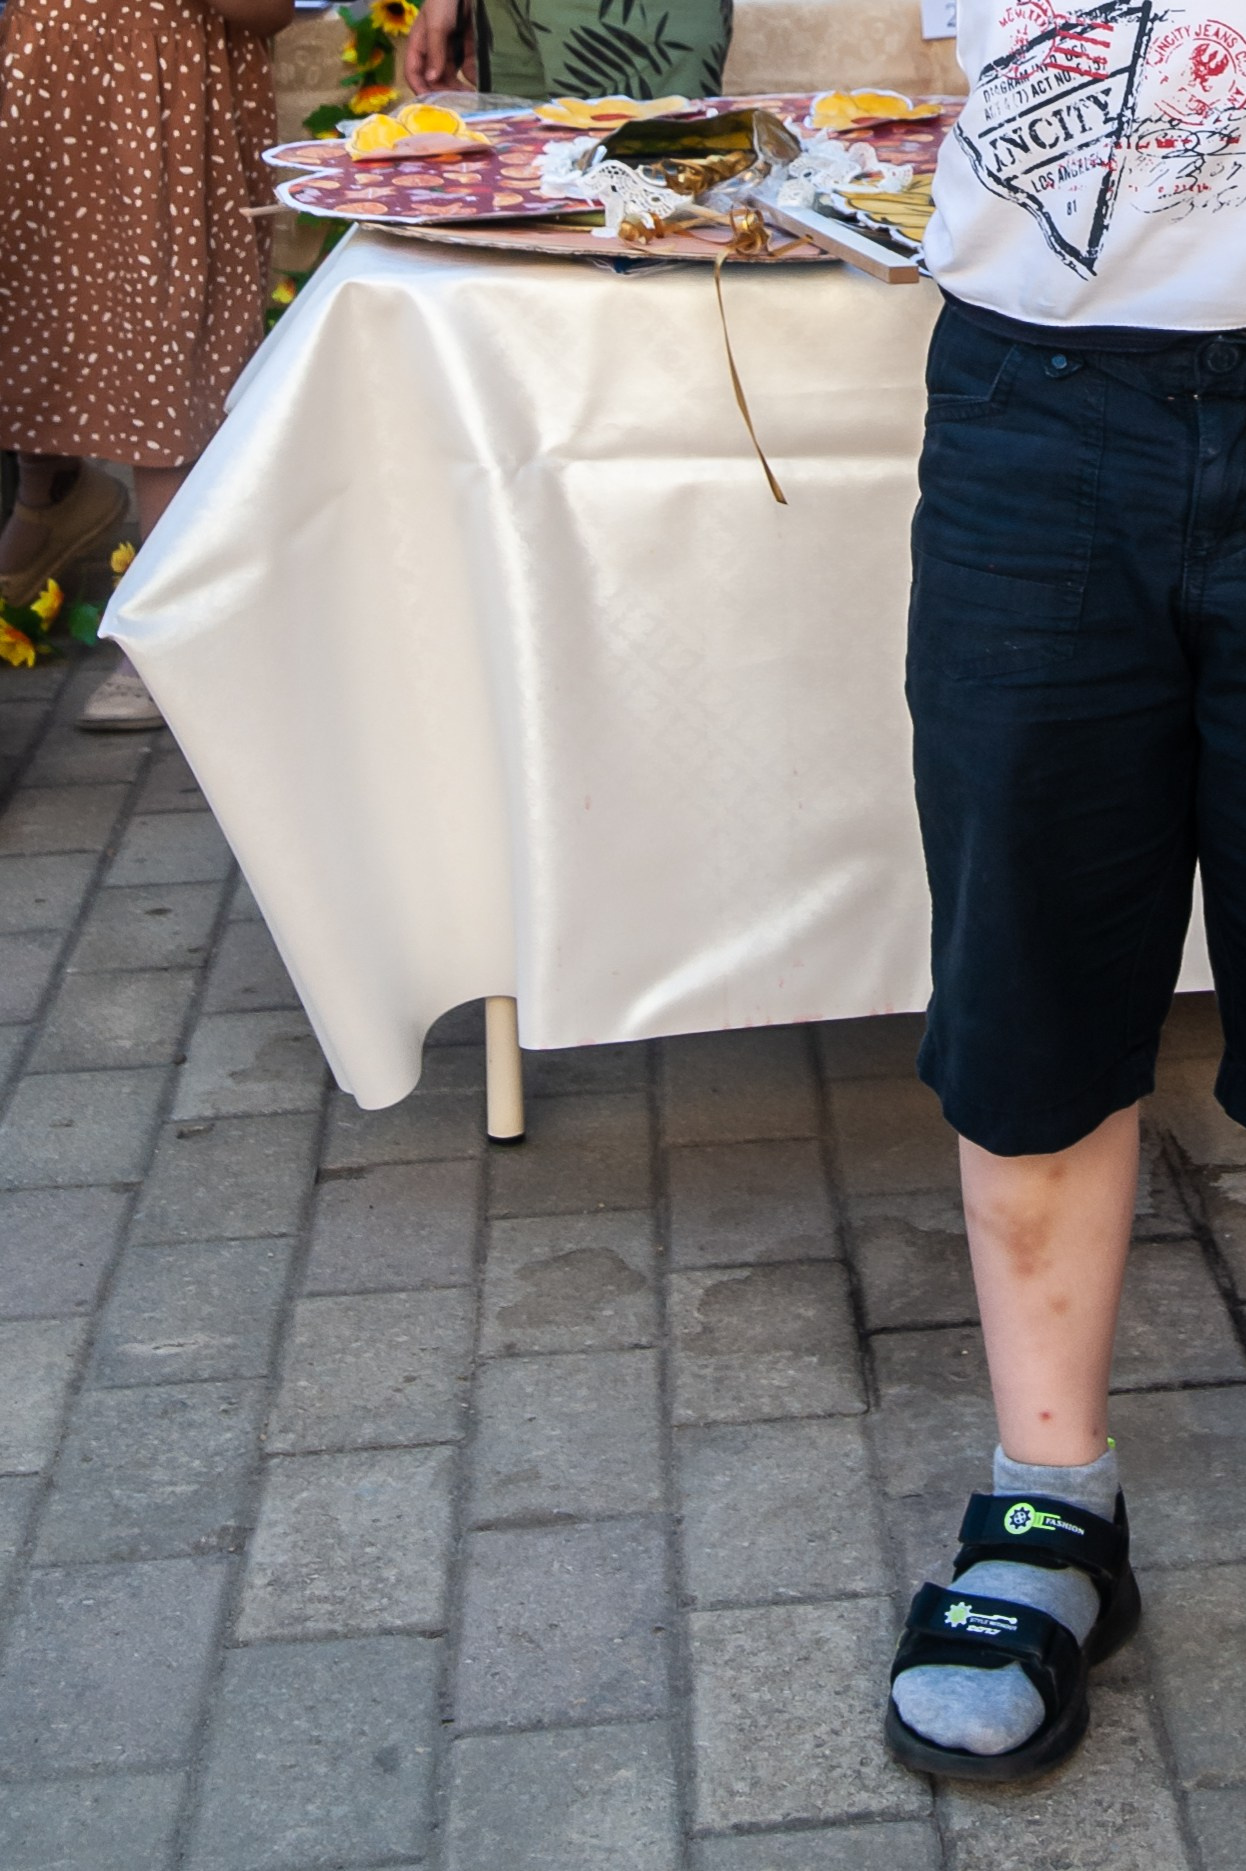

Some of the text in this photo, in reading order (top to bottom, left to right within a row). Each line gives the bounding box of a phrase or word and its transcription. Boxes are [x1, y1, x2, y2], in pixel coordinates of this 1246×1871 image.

[1194, 24, 1238, 49] JEANS
[1030, 76, 1054, 99] ACT
[989, 87, 1119, 174] INCITY
[1045, 1517, 1085, 1536] FASHION
